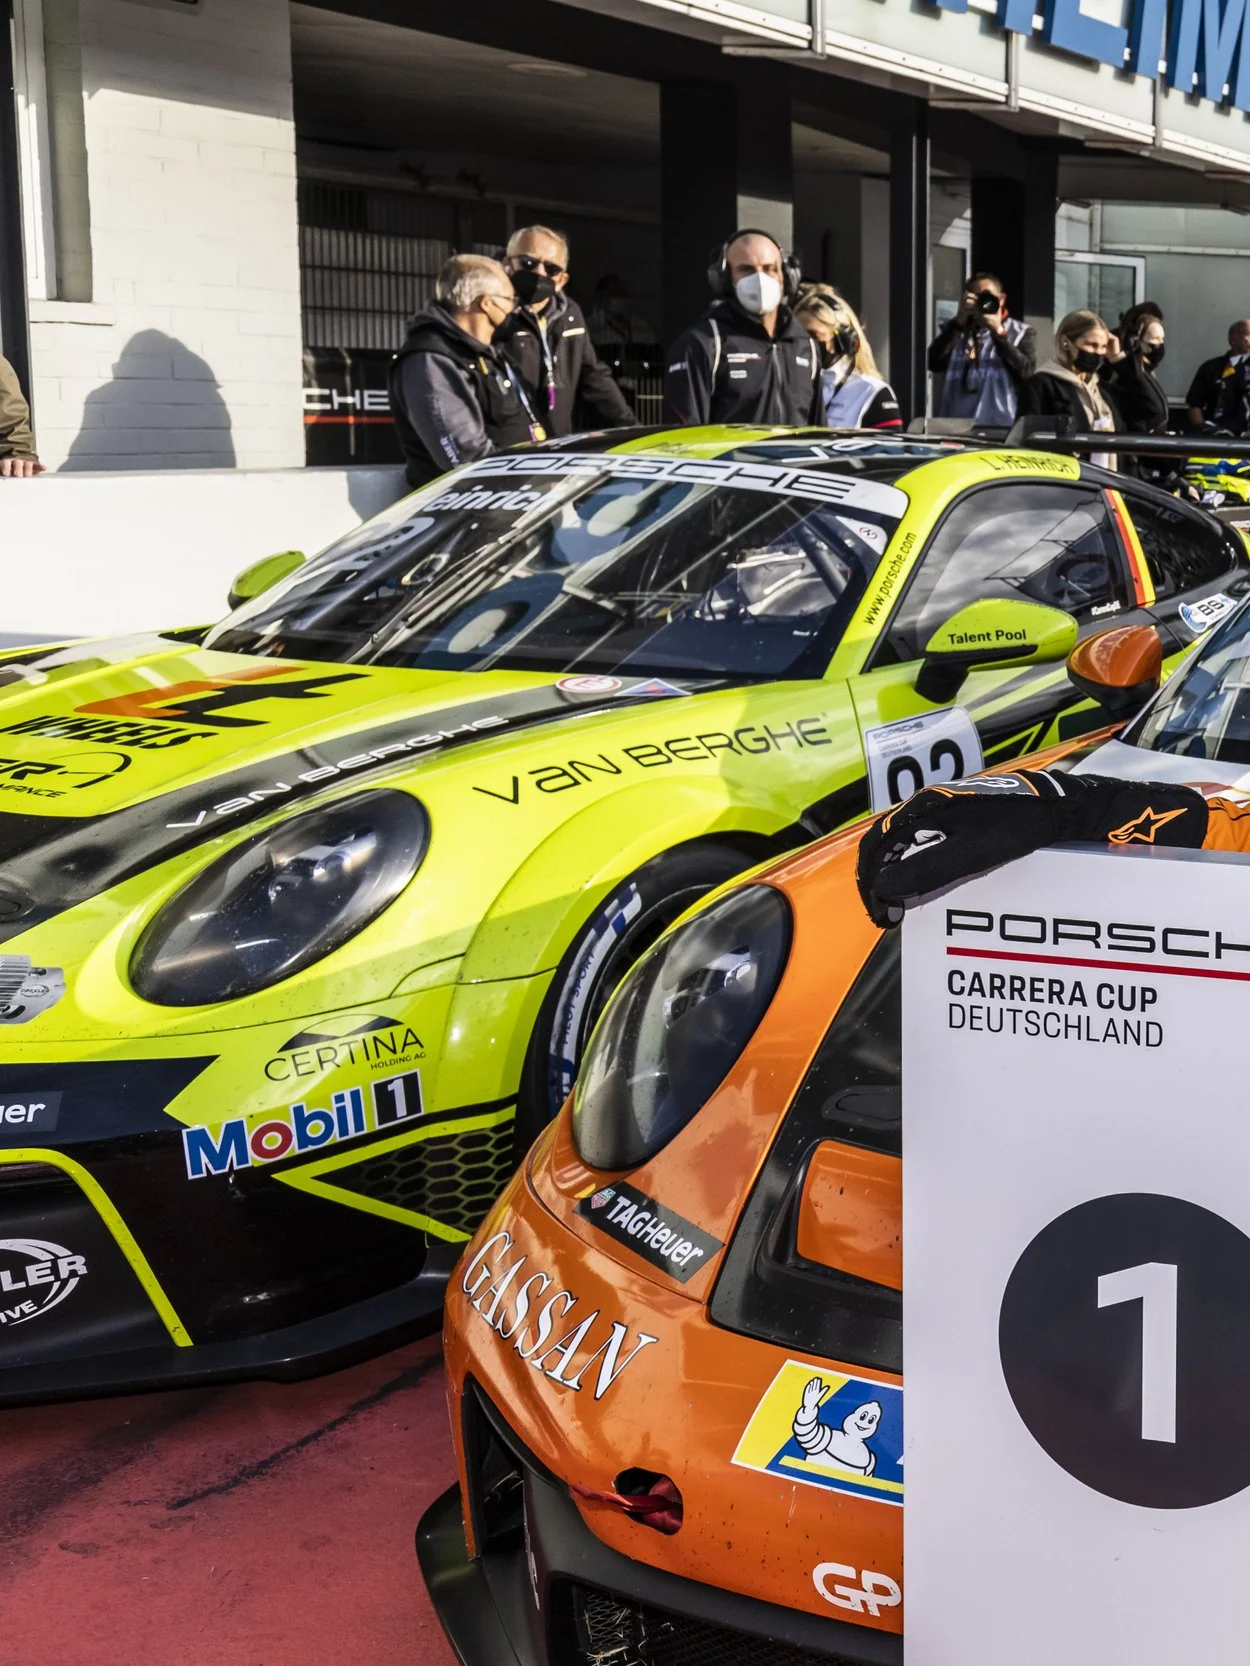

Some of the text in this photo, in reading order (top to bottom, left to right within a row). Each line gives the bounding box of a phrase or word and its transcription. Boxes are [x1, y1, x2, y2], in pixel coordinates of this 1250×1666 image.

[480, 456, 857, 500] PORSCHE
[863, 532, 917, 625] www.porsche.com
[948, 629, 1027, 644] Talent Pool
[298, 715, 510, 783] BERGHE
[624, 717, 833, 768] BERGHE
[947, 969, 1158, 1013] CARRERA CUP
[948, 1003, 1164, 1048] DEUTSCHLAND
[263, 1028, 425, 1082] CERTINA
[370, 1051, 426, 1070] HOLDING AG
[183, 1087, 364, 1180] Mobil
[461, 1231, 659, 1401] GASSAN
[1094, 1262, 1178, 1443] 1
[811, 1561, 902, 1617] GP
